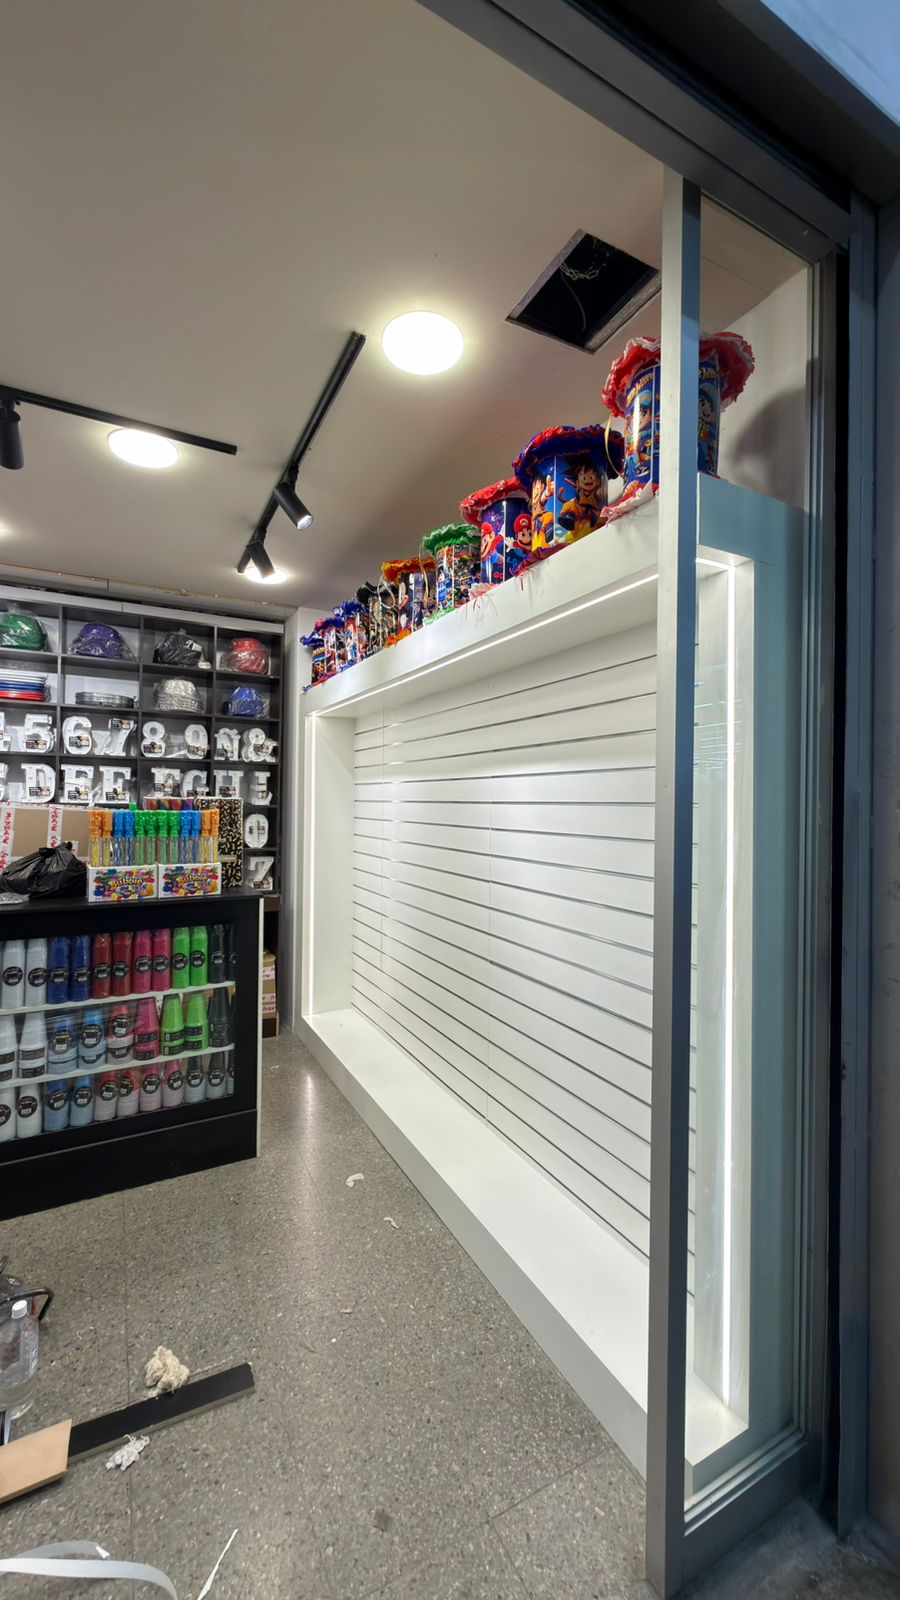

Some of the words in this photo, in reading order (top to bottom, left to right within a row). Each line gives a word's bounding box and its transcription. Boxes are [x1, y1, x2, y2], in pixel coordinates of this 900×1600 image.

[24, 713, 52, 753] 5
[62, 715, 92, 755] 6
[104, 717, 134, 756] 7
[141, 721, 166, 758] 8
[184, 723, 208, 760] 9
[242, 727, 278, 763] &
[21, 763, 56, 803] D
[99, 765, 131, 804] E
[213, 770, 244, 798] H
